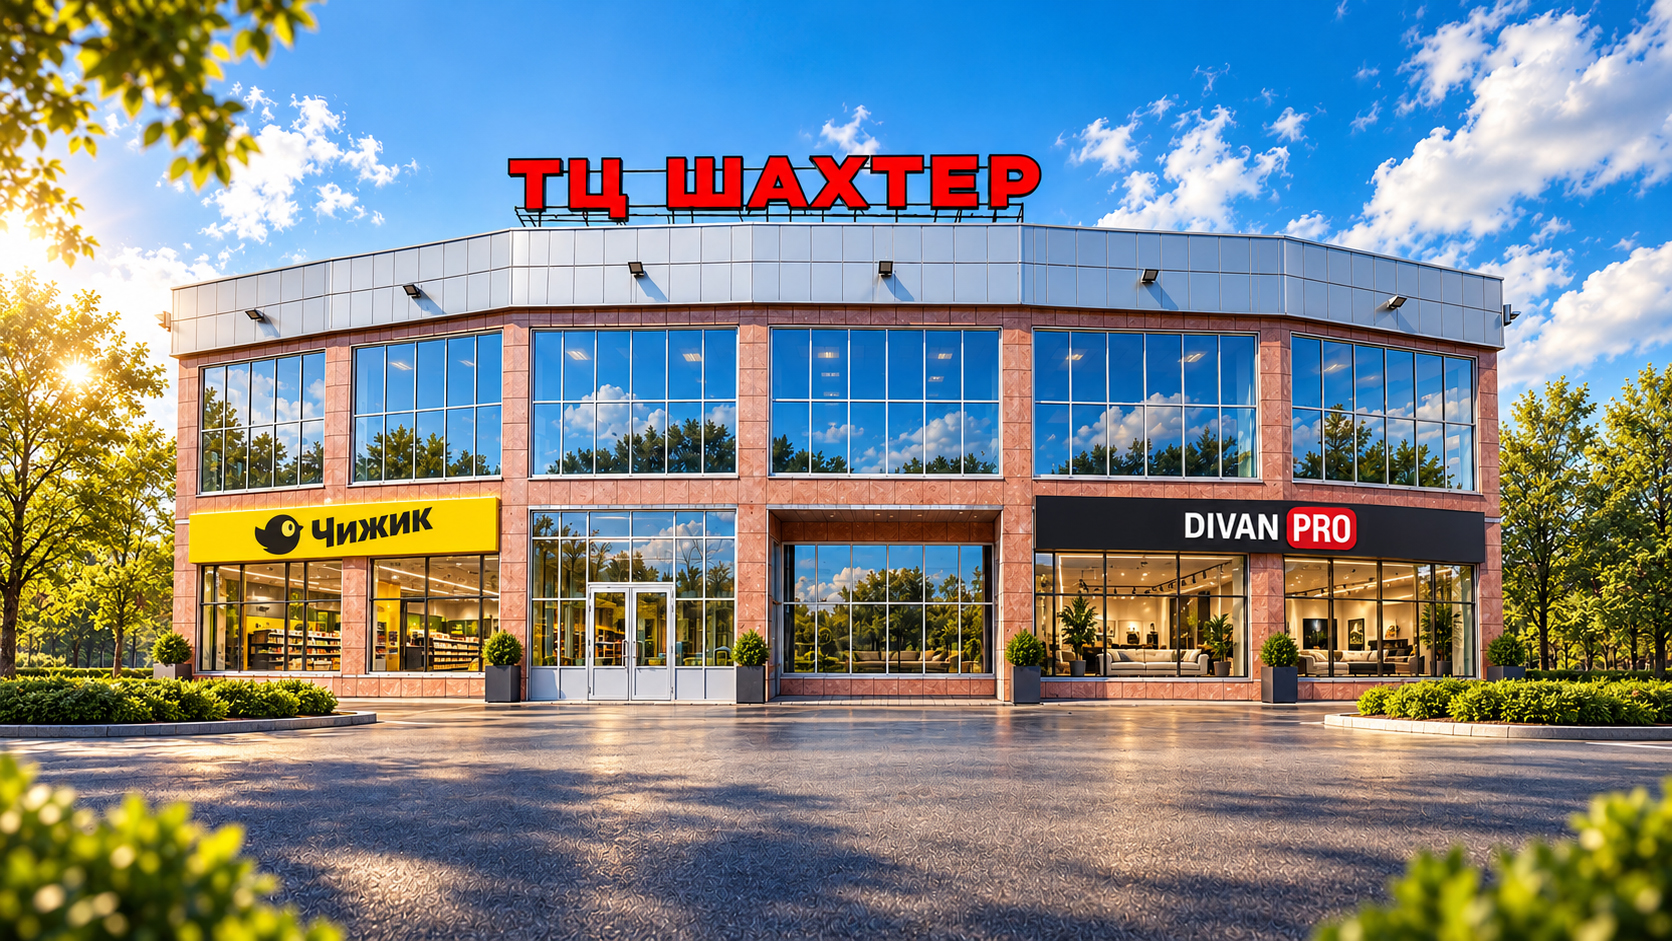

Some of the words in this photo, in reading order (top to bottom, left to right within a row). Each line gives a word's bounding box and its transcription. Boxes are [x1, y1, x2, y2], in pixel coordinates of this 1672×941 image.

[508, 157, 628, 220] ТЦ
[666, 154, 1041, 209] ШАХТЕР
[311, 506, 433, 548] Чижик
[1184, 512, 1279, 541] DIVAN
[1293, 513, 1352, 543] PRO
